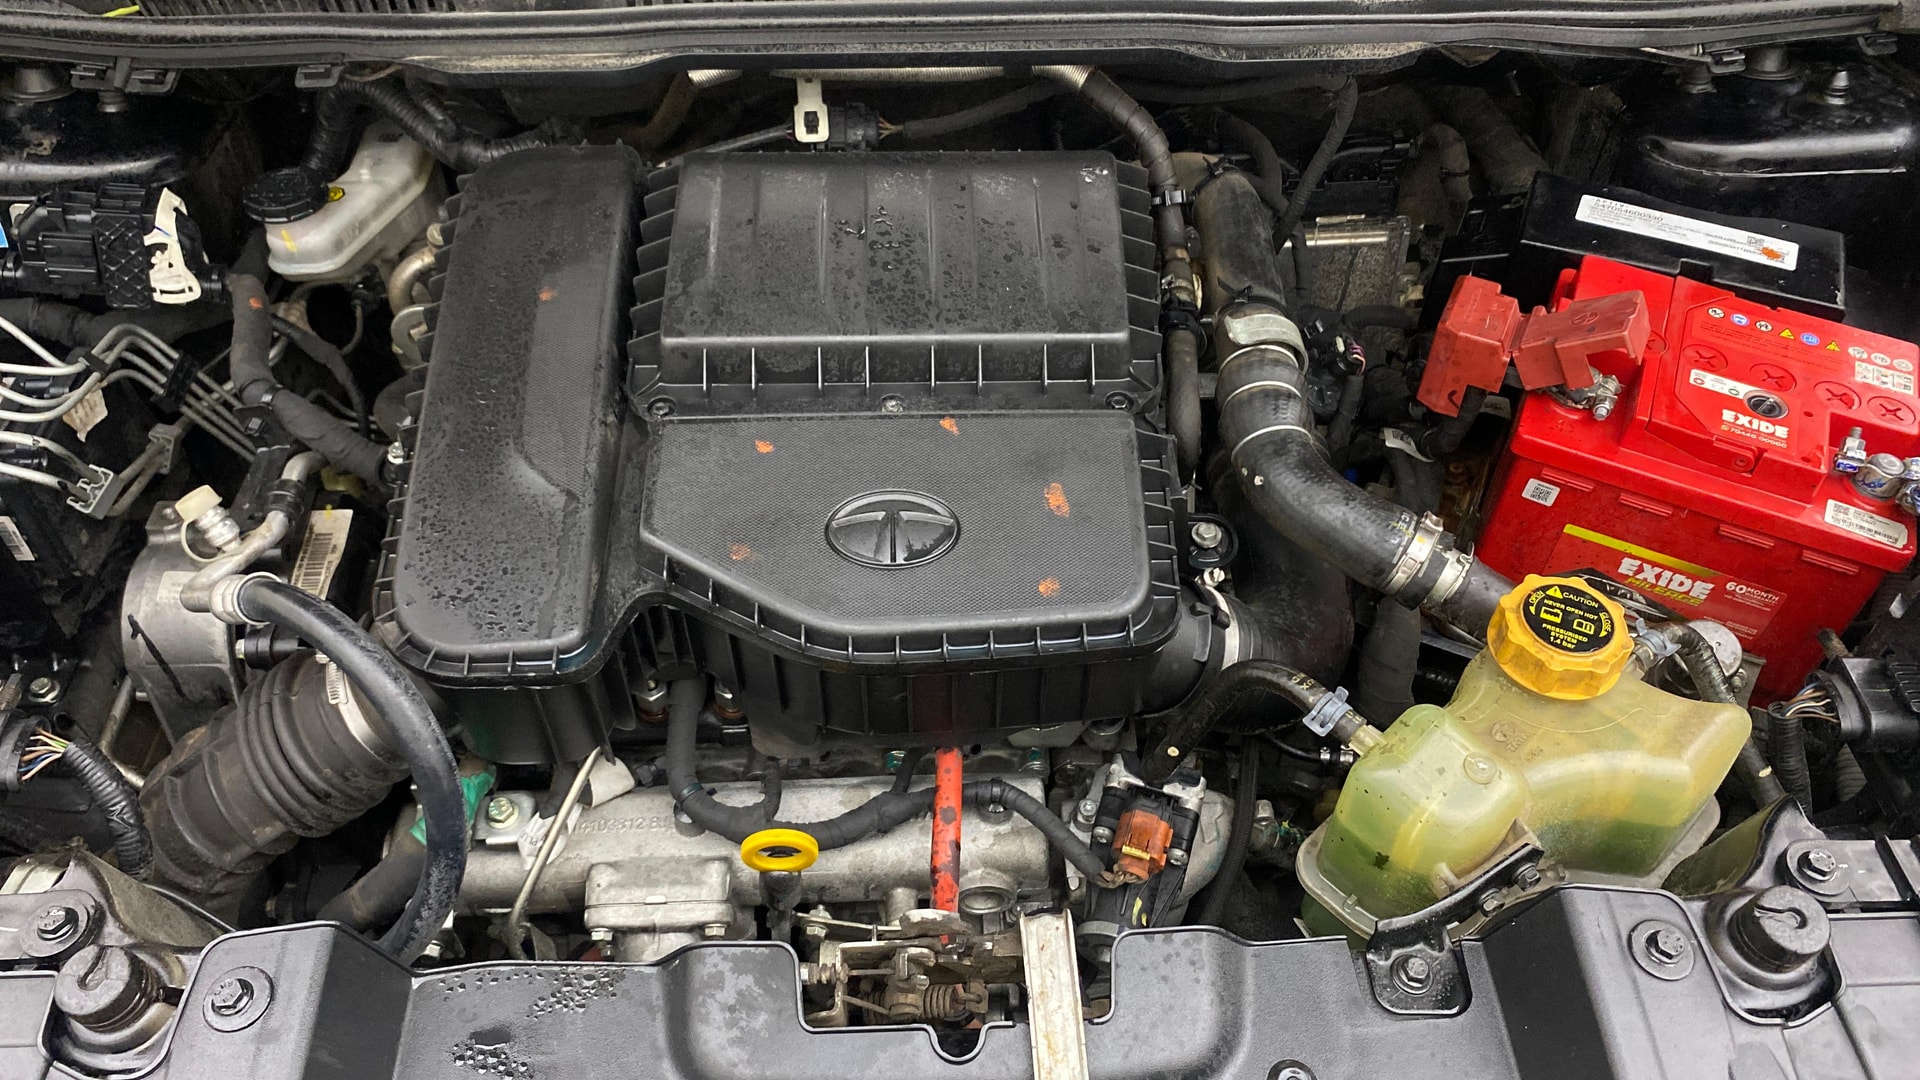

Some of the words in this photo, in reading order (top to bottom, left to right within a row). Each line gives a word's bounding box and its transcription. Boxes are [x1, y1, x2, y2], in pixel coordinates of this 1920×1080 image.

[1721, 408, 1790, 439] EXIDE
[1617, 556, 1715, 600] EXIDE
[1529, 590, 1543, 603] OPEN
[1563, 592, 1599, 608] CAUTION
[1624, 577, 1705, 607] MILEAGE
[1725, 581, 1747, 594] 60
[1746, 586, 1780, 602] MONTH
[1544, 599, 1565, 608] NEVER
[1566, 606, 1583, 615] OPEN
[1584, 612, 1598, 621] HOT
[1600, 612, 1611, 632] CLOSE
[1542, 623, 1588, 643] PRESSURISED
[1551, 632, 1577, 643] SYSTEM
[1563, 640, 1576, 649] bar
